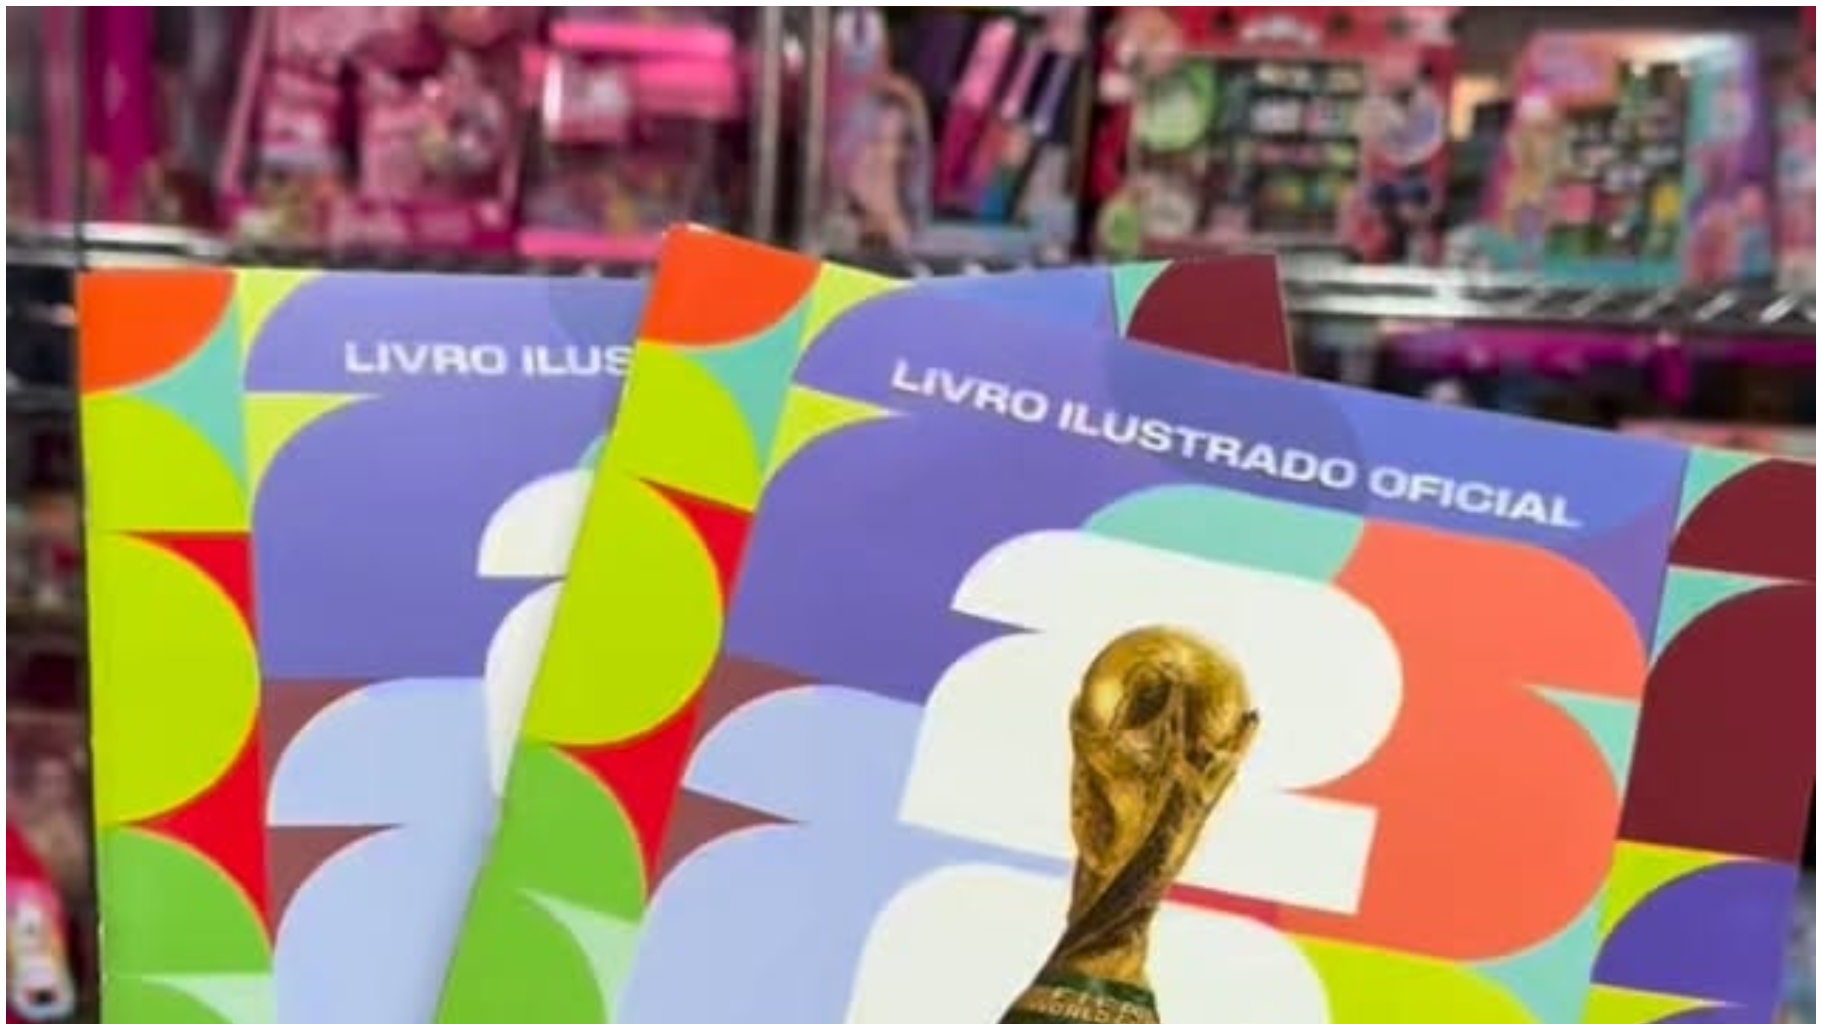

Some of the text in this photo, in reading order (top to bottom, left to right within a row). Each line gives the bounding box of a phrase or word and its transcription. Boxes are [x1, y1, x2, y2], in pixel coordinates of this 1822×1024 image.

[344, 341, 508, 375] LIVRO
[891, 357, 1584, 528] LIVRO ILUSTRADO OFICIAL
